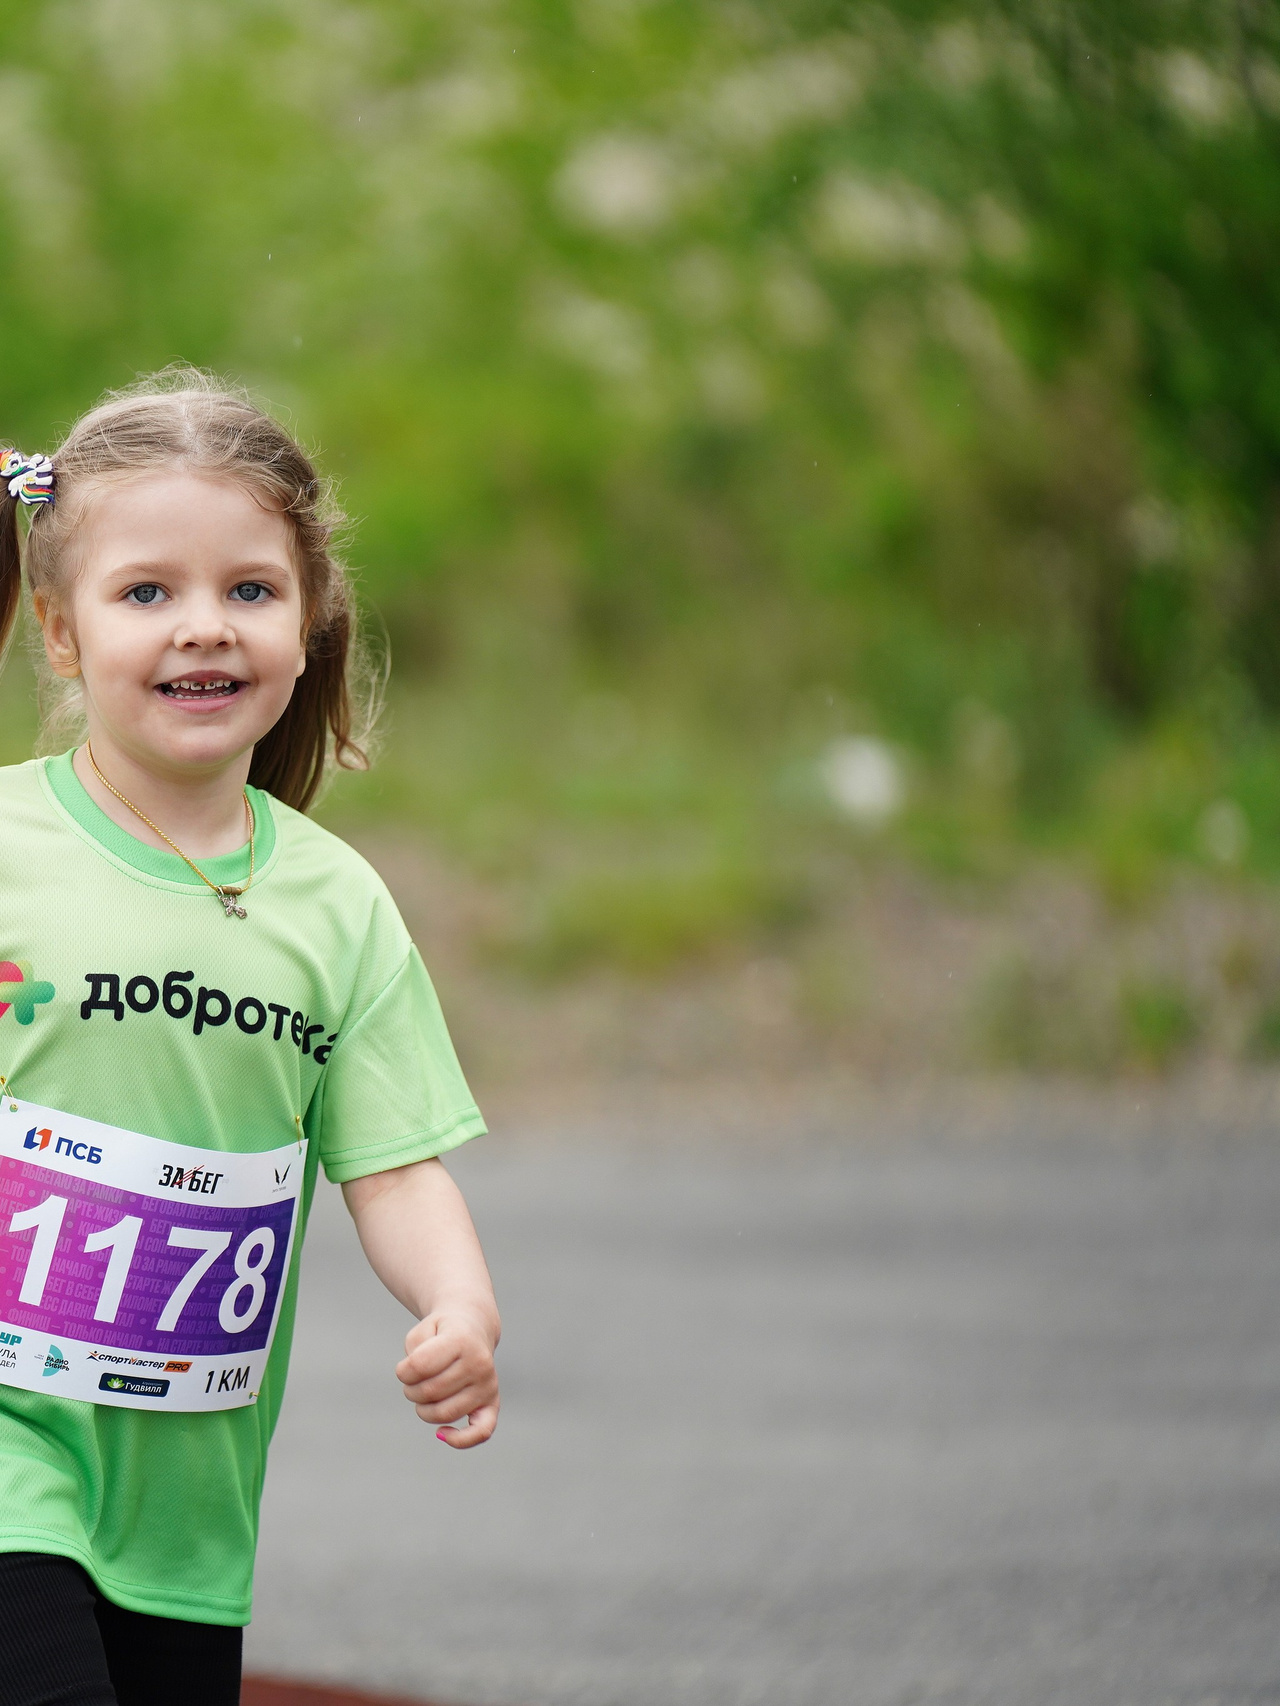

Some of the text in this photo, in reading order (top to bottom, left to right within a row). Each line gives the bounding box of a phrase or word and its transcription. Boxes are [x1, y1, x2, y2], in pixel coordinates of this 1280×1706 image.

[55, 1136, 103, 1165] ПСБ
[8, 1194, 275, 1335] 1178
[0, 1359, 17, 1369] ДЕЛ
[44, 1361, 70, 1372] СИБИРЬ
[46, 1356, 69, 1366] РАДИО
[165, 1361, 191, 1373] PRO
[205, 1366, 251, 1394] 1 КМ
[125, 1382, 162, 1393] Гудвилл
